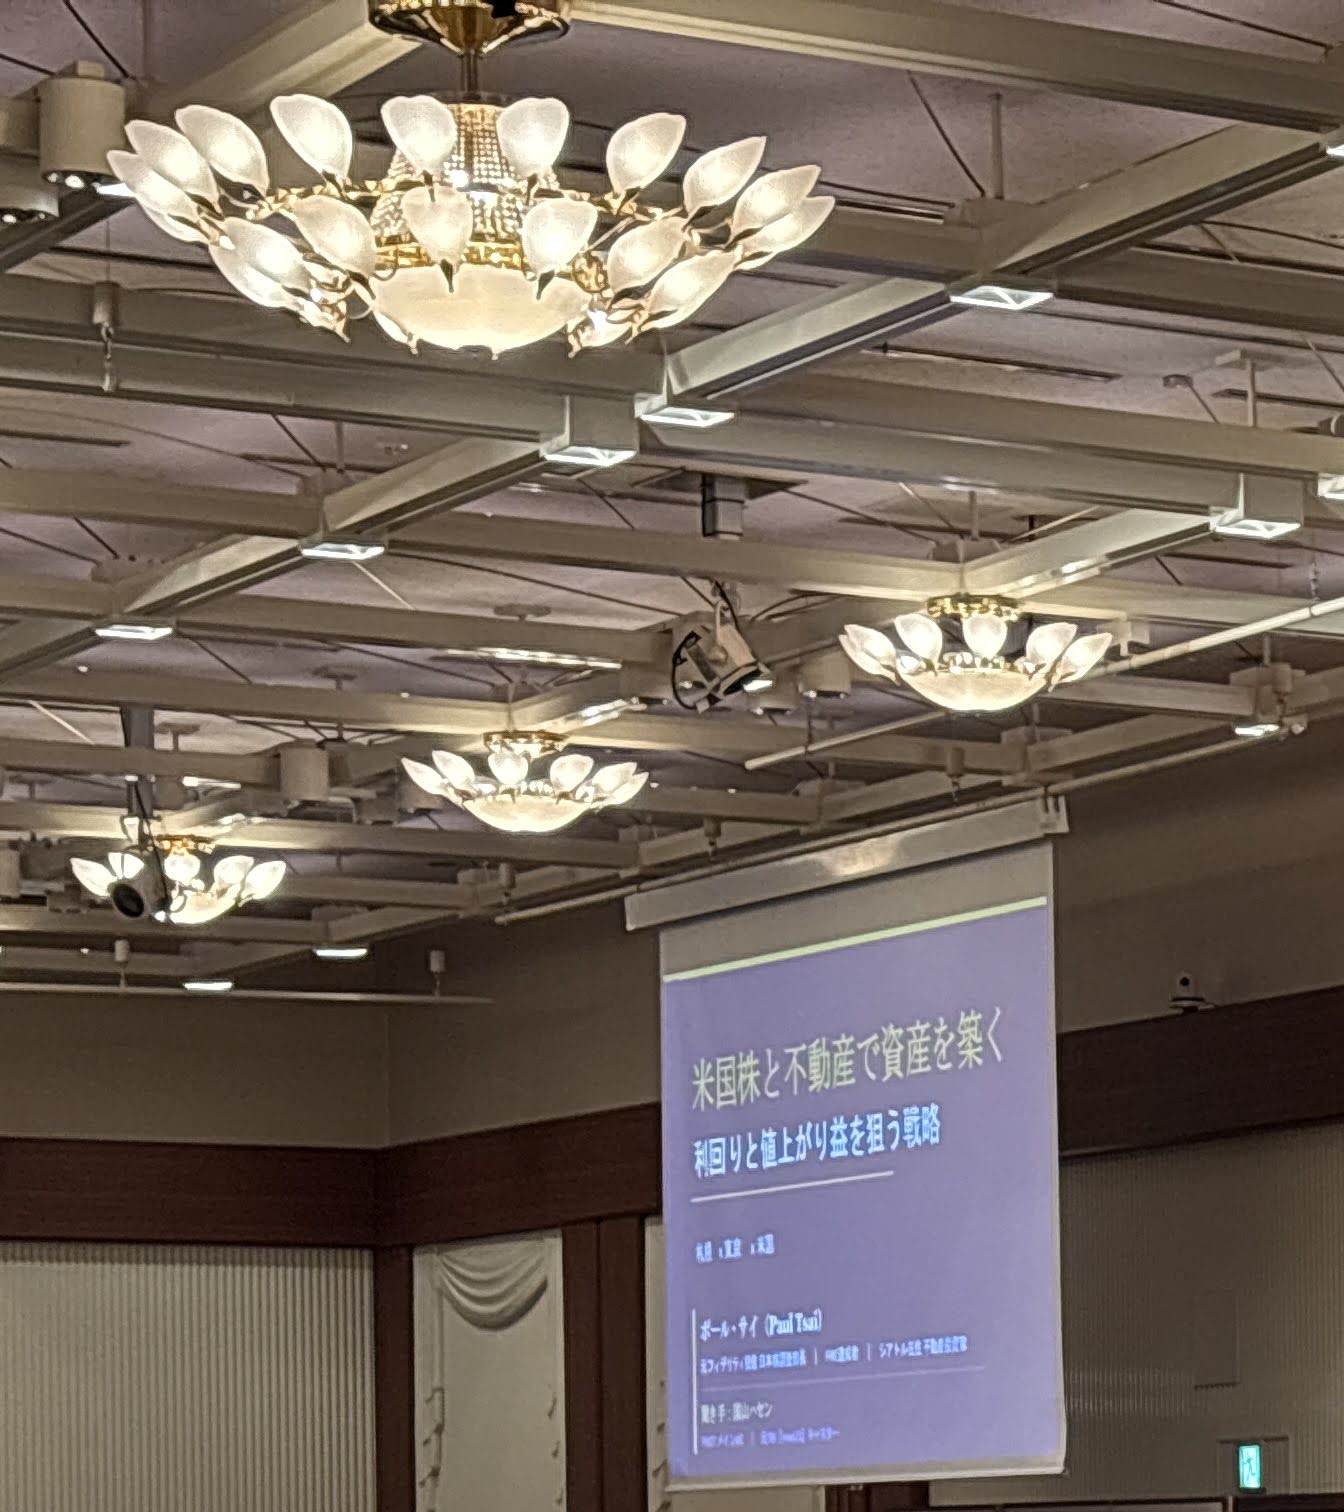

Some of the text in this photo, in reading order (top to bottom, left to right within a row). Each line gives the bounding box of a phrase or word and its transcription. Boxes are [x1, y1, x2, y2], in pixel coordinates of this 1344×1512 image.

[692, 1006, 1005, 1112] 米国株と不動産で資産を築く
[693, 1102, 942, 1178] 利回りと値上がり益を狙う戦略
